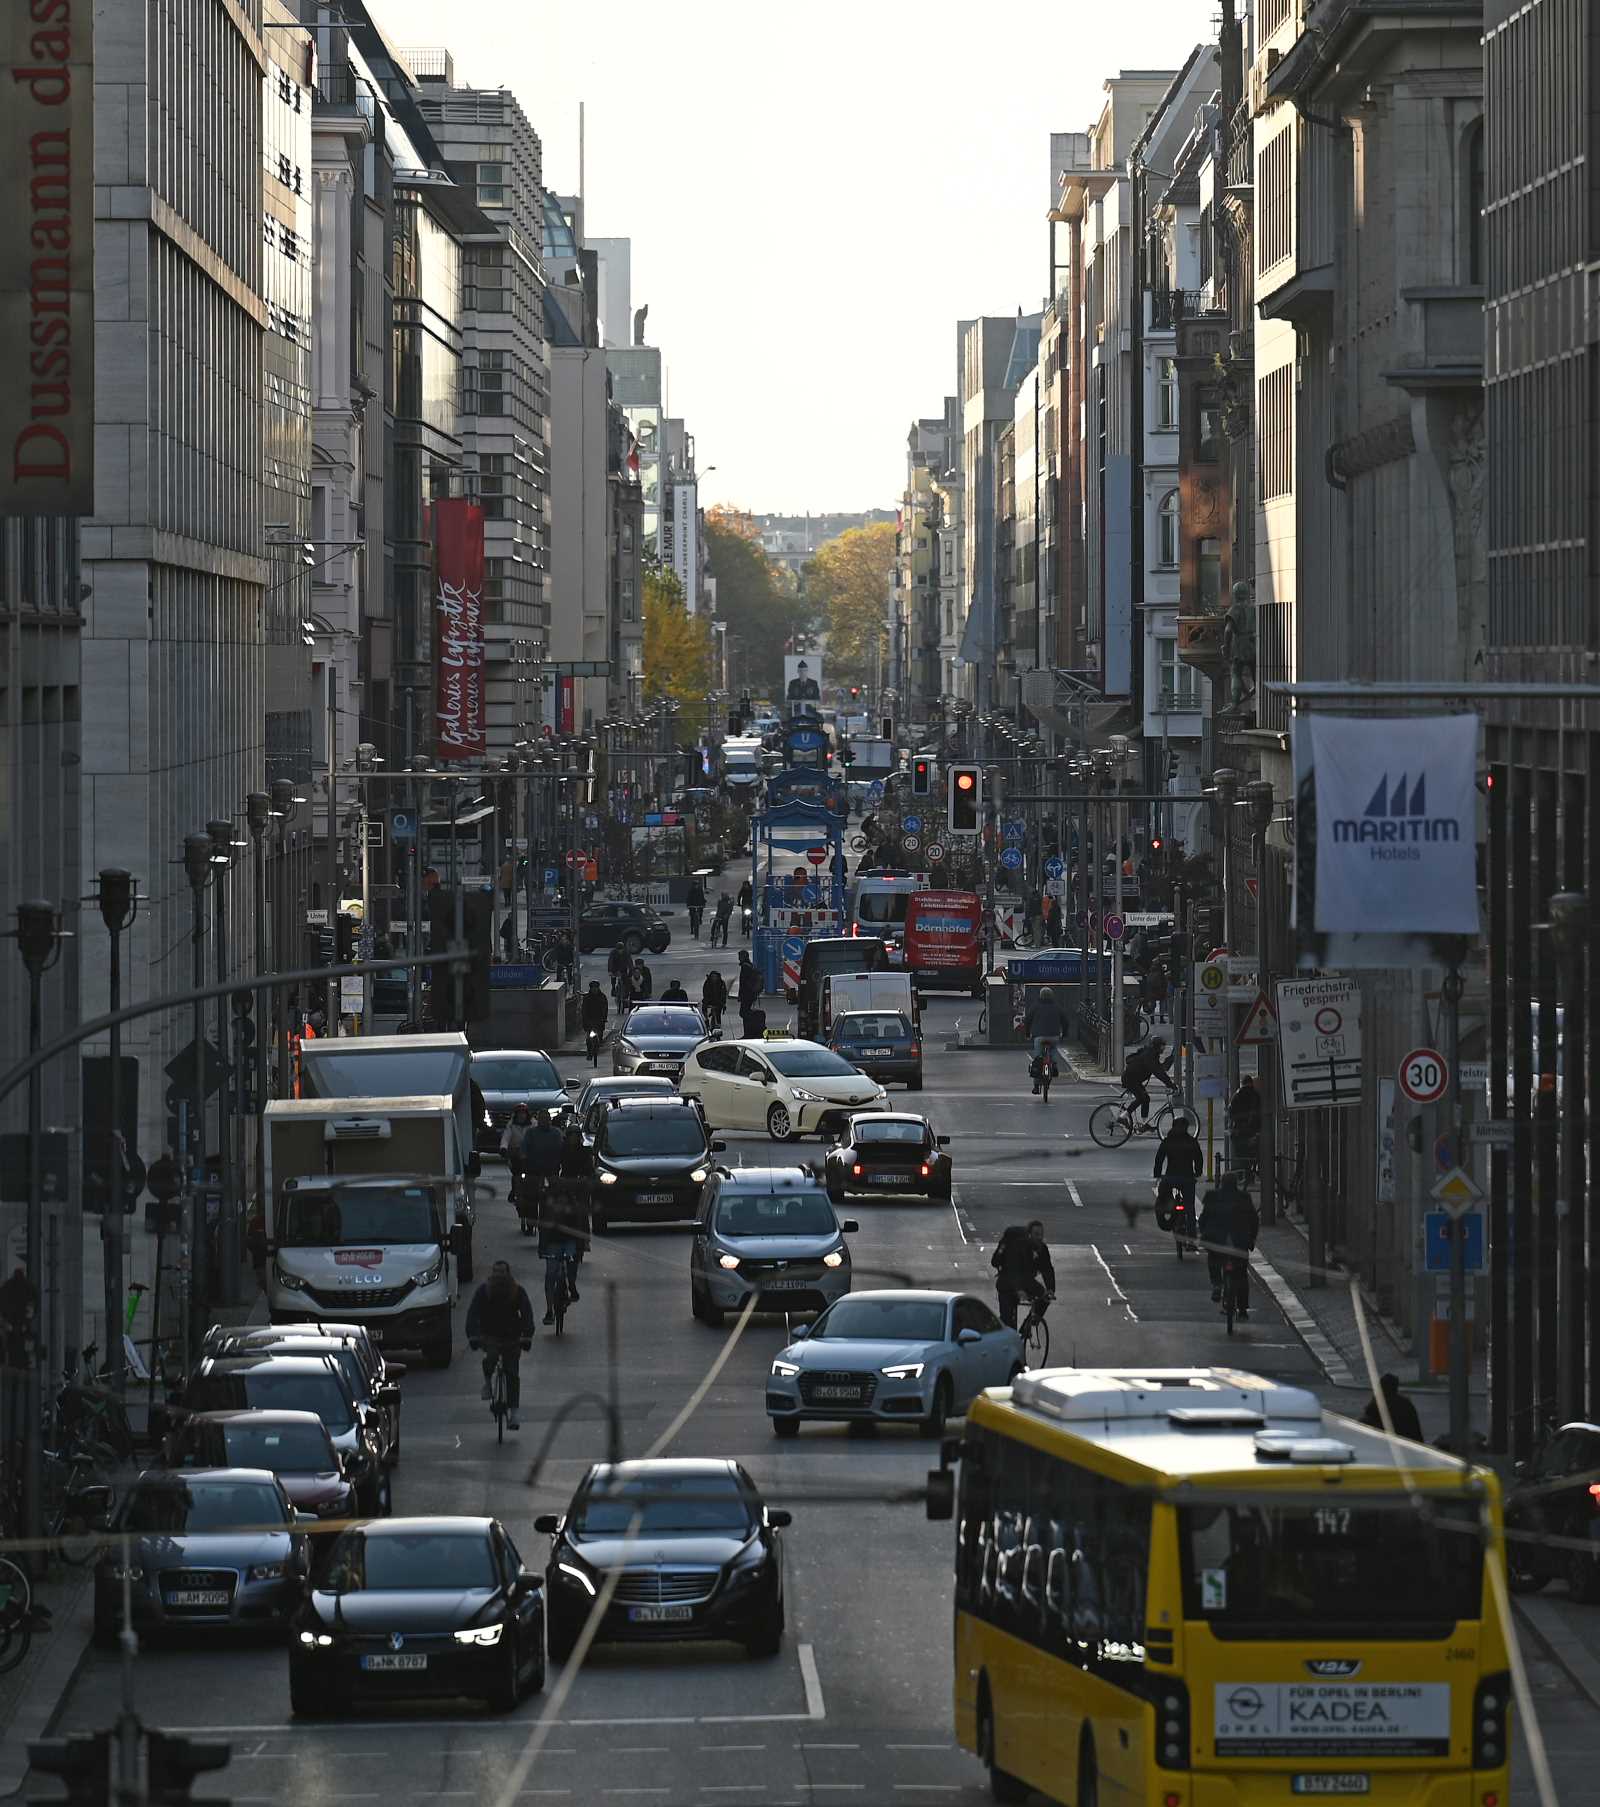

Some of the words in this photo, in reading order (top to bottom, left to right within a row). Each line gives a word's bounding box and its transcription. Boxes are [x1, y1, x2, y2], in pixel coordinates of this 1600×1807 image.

[13, 0, 71, 106] das
[13, 128, 71, 485] Dussmann
[664, 525, 673, 548] MUR
[664, 554, 673, 563] LE
[437, 575, 466, 666] Lafayette
[1333, 819, 1460, 843] MARITIM
[929, 847, 940, 857] 20
[1370, 846, 1421, 862] Hotels
[544, 870, 554, 882] P
[1129, 914, 1145, 922] Unter
[1146, 914, 1156, 922] den
[1011, 963, 1022, 975] U
[1303, 990, 1350, 1008] gesperrt
[1409, 1064, 1438, 1088] 30
[1314, 1508, 1351, 1534] 147
[1290, 1687, 1314, 1697] FÜR
[1318, 1688, 1350, 1698] OPEL
[1355, 1688, 1367, 1698] IN
[1371, 1688, 1422, 1698] BERLIN!
[1290, 1702, 1388, 1722] KADEA
[1220, 1724, 1271, 1734] OPEL
